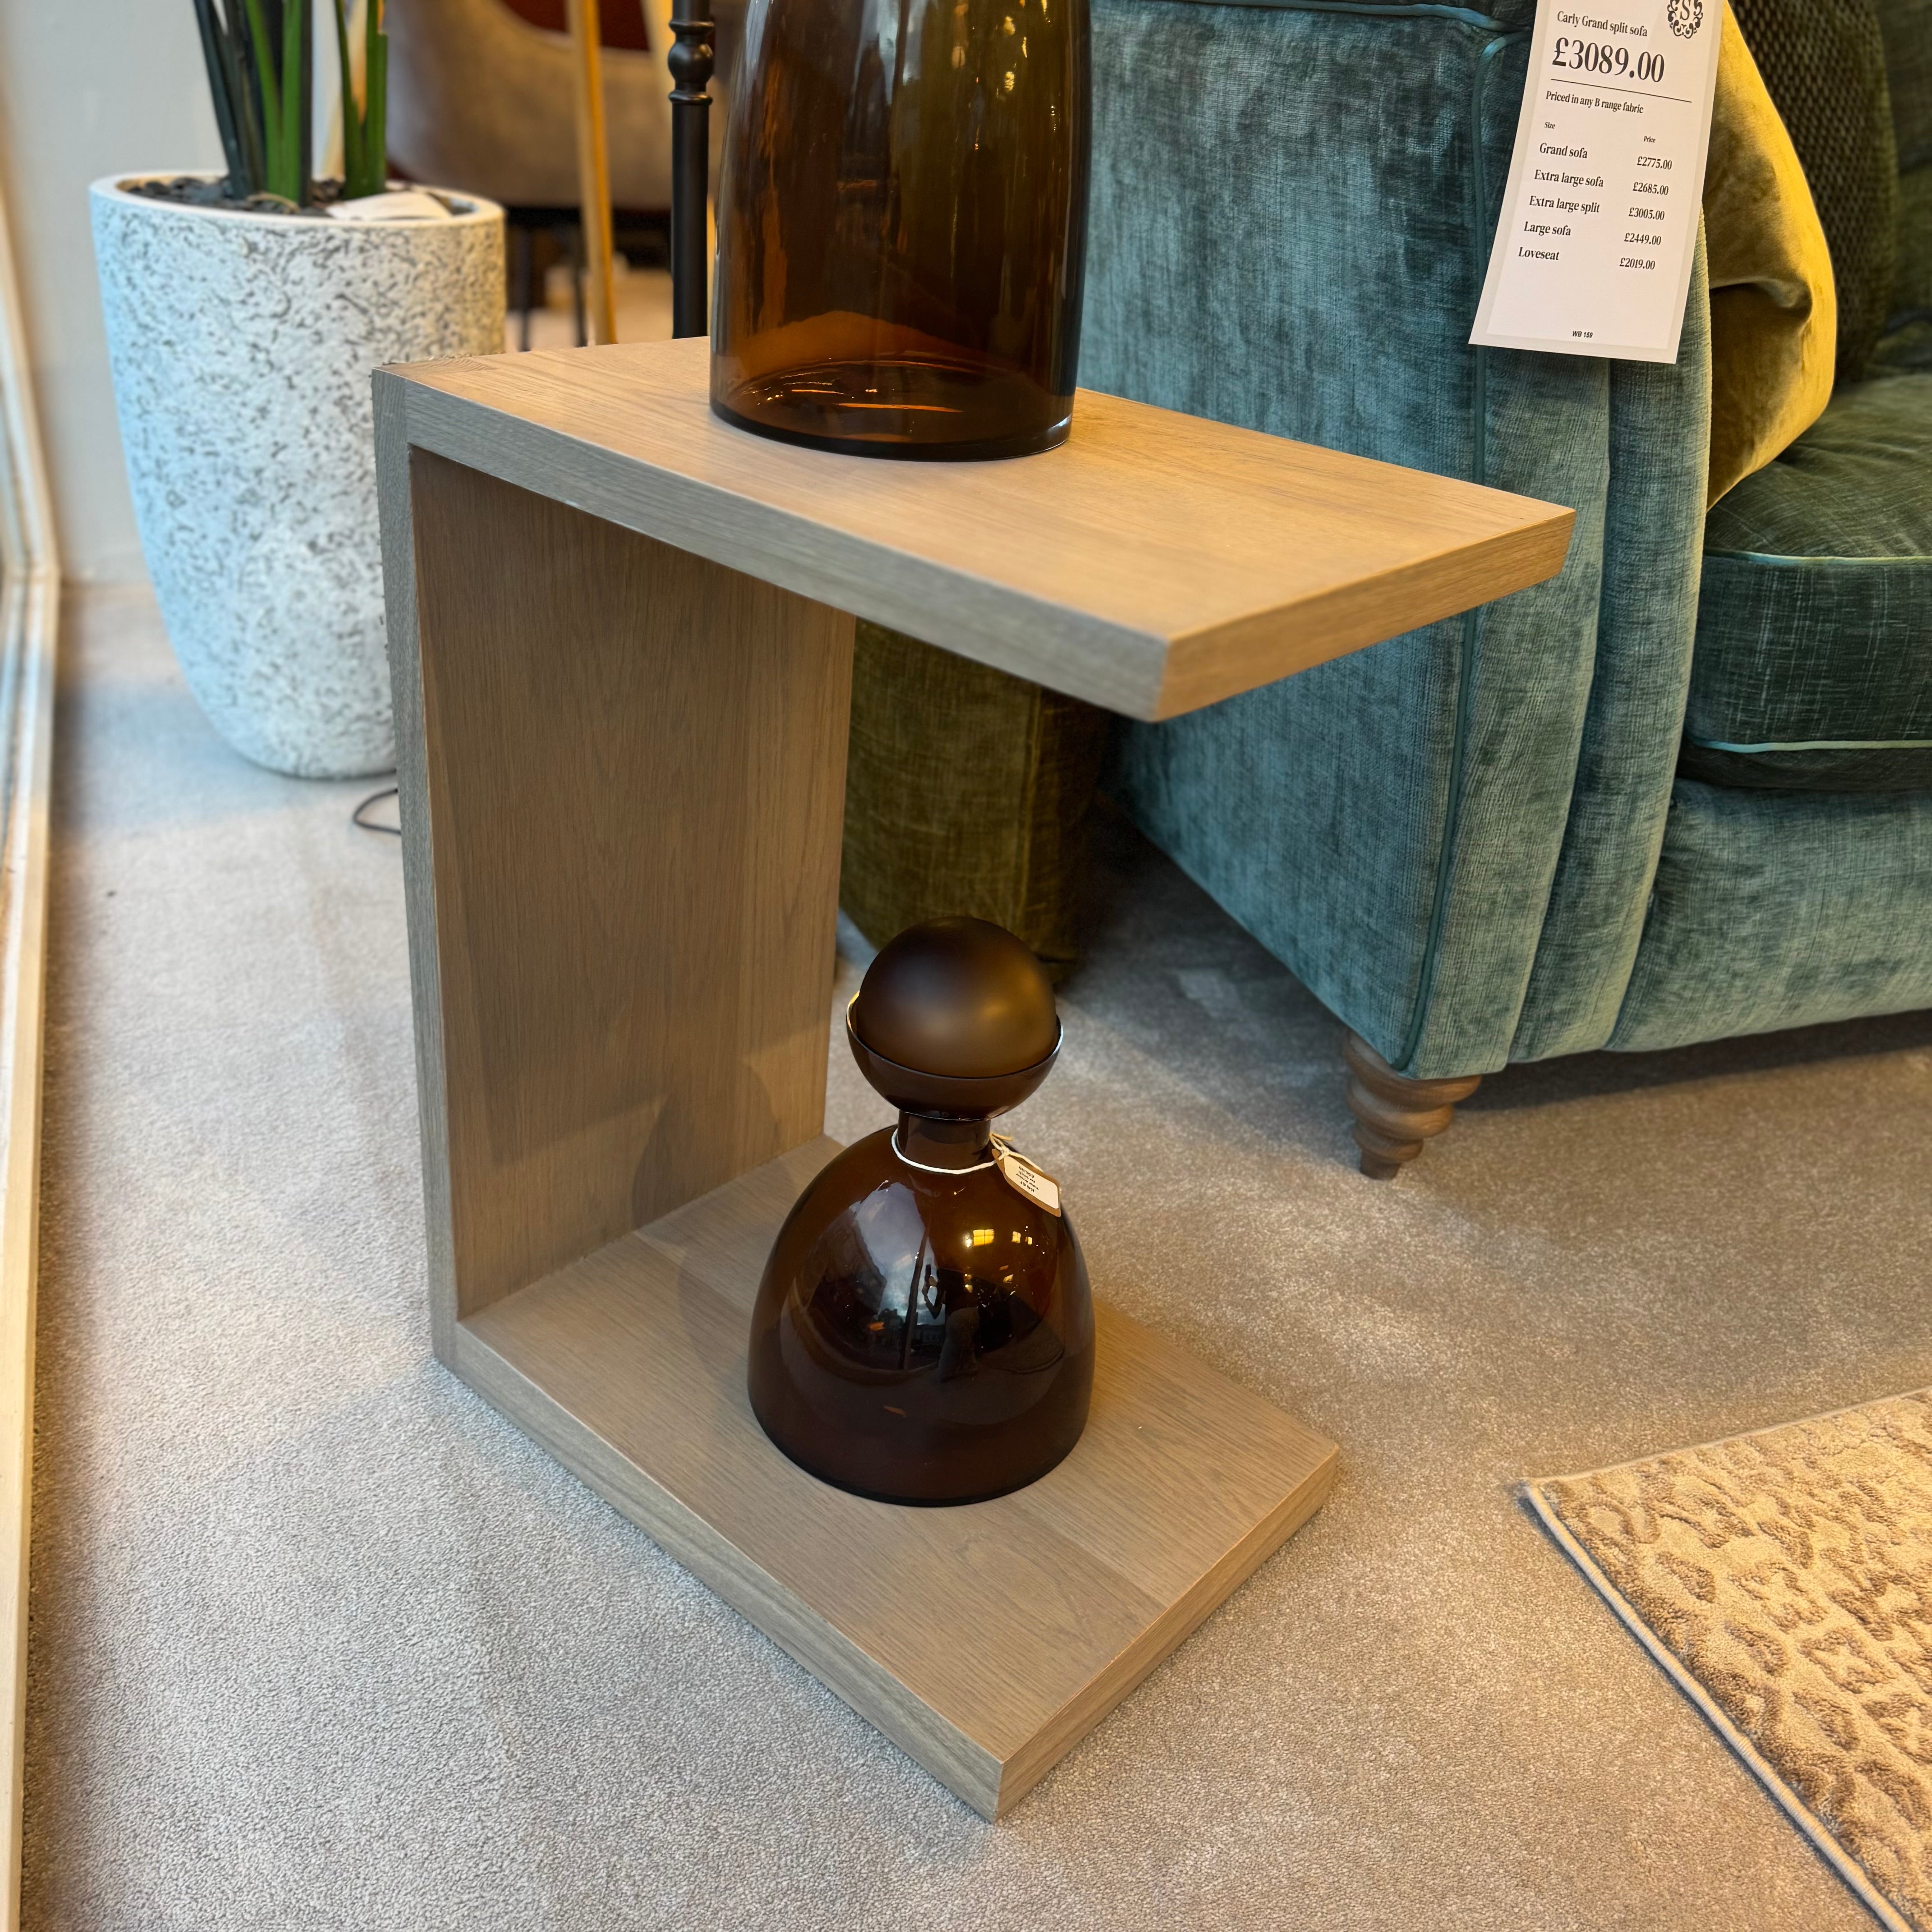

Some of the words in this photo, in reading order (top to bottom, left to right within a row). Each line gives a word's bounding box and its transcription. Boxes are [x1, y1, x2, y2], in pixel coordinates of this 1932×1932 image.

[1557, 11, 1581, 28] Carly
[1582, 15, 1609, 30] Grand
[1610, 22, 1628, 35] split
[1629, 25, 1647, 37] sofa
[1552, 37, 1665, 83] £3089.00
[1546, 90, 1571, 103] Priced
[1580, 98, 1594, 108] any
[1594, 98, 1600, 107] B
[1601, 101, 1622, 112] range
[1623, 101, 1644, 114] fabric
[1540, 143, 1568, 156] Grand
[1569, 147, 1587, 159] sofa
[1637, 156, 1672, 170] £2775.00
[1534, 169, 1559, 182] Extra
[1561, 172, 1584, 187] large
[1585, 176, 1604, 187] sofa
[1633, 182, 1669, 195] £2685.00
[1529, 195, 1555, 208] Extra
[1556, 198, 1579, 213] large
[1580, 202, 1600, 215] split
[1628, 207, 1665, 221] £3005.00
[1524, 221, 1550, 236] Large
[1552, 225, 1571, 236] sofa
[1624, 232, 1661, 246] £2449.00
[1518, 247, 1559, 261] Loveseat
[1619, 258, 1656, 270] £2019.00
